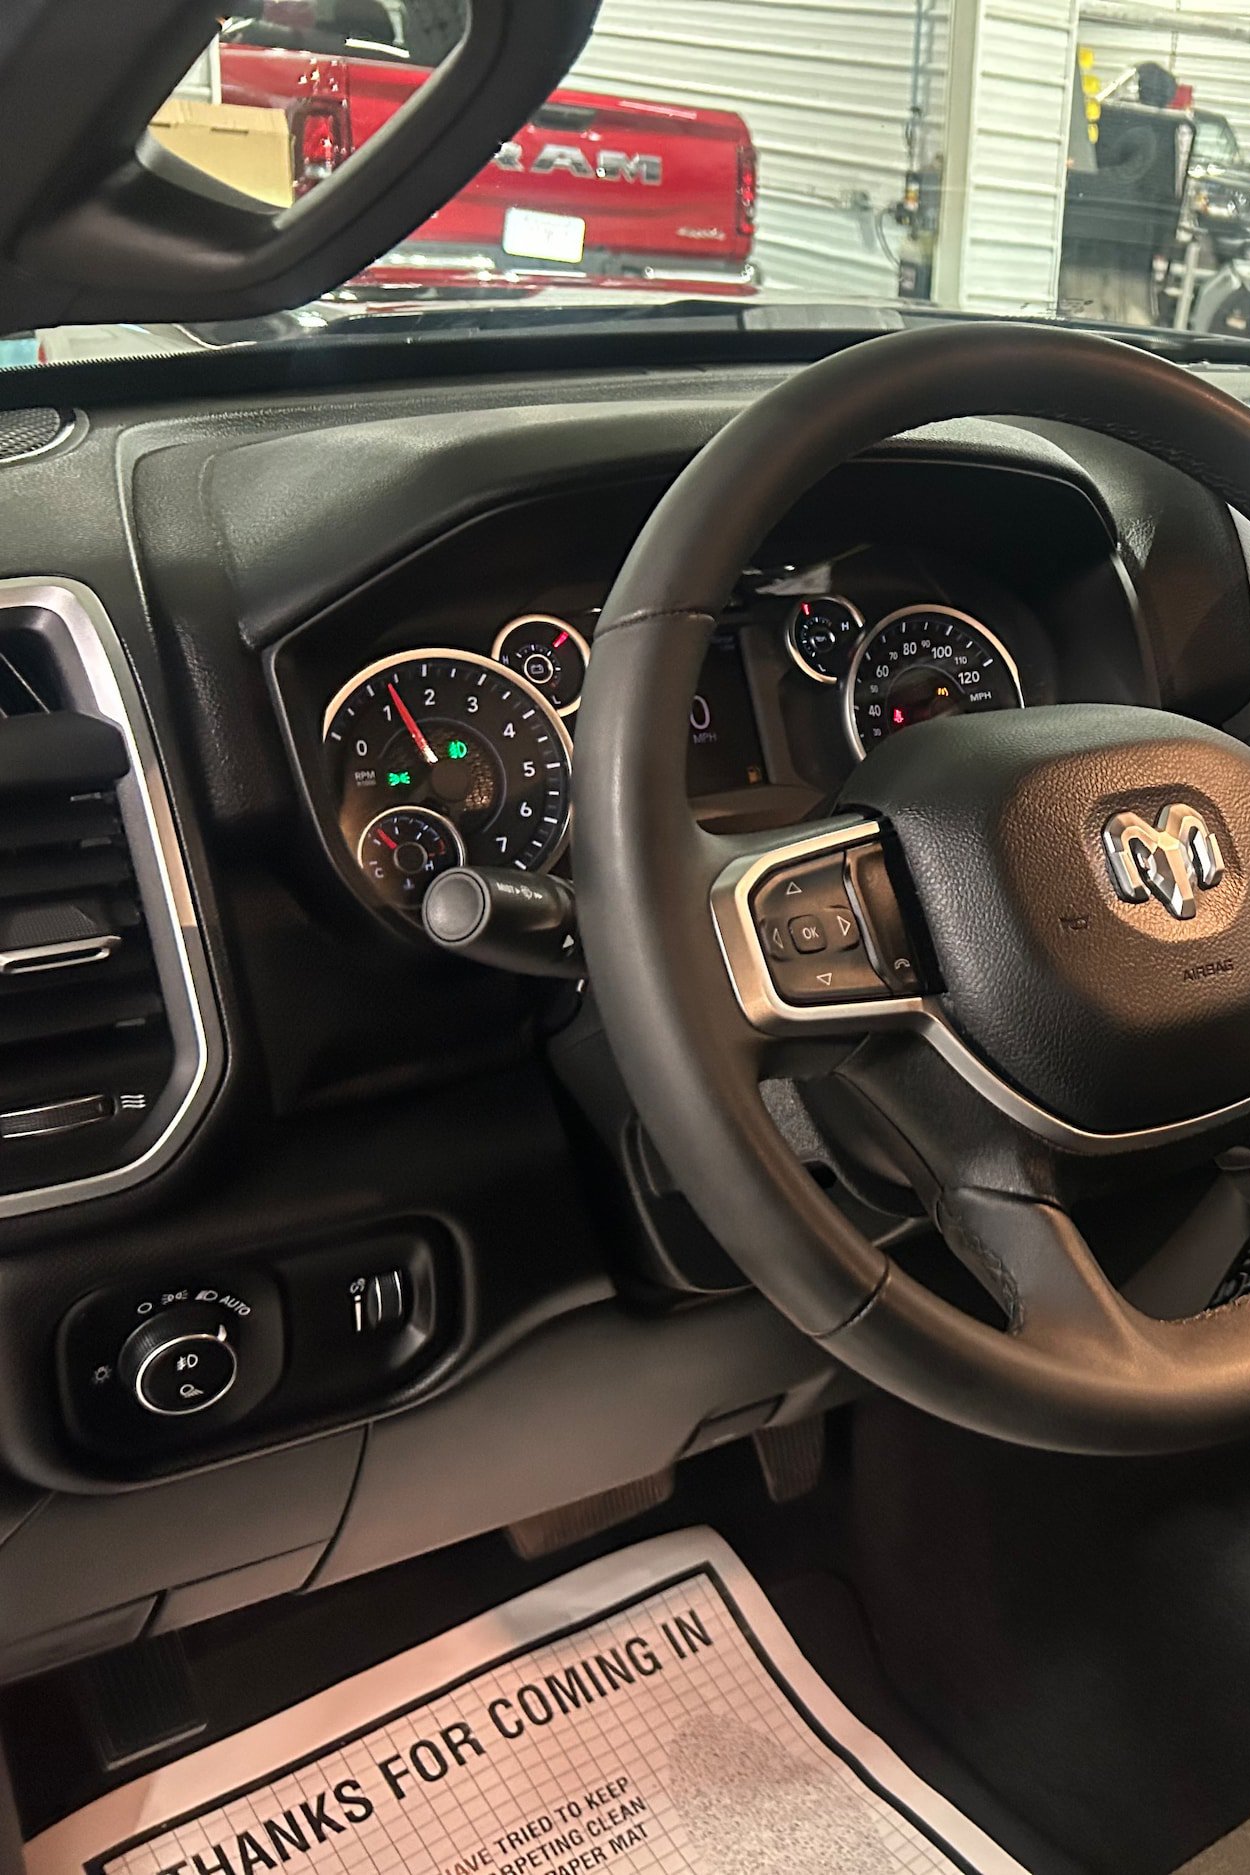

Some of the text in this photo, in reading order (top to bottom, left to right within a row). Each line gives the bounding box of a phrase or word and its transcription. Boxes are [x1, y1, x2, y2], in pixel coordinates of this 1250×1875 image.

[494, 141, 662, 186] RAM
[903, 642, 917, 656] 80
[931, 646, 952, 660] 100
[876, 665, 889, 678] 60
[958, 671, 980, 685] 120
[424, 689, 436, 705] 2
[970, 691, 992, 702] MPH
[383, 705, 392, 721] 1
[467, 697, 479, 713] 3
[868, 704, 881, 717] 40
[503, 723, 515, 738] 4
[356, 740, 368, 756] 0
[355, 770, 376, 781] RPM
[523, 761, 536, 777] 5
[519, 802, 533, 817] 6
[496, 837, 508, 852] 7
[802, 927, 819, 940] OK
[1183, 959, 1234, 982] AIRBAG
[219, 1295, 251, 1316] AUTO
[377, 1721, 487, 1801] FOR
[487, 1636, 663, 1740] COMING
[661, 1609, 715, 1660] IN
[443, 1776, 629, 1875] AVE TRIED TO KEEP
[489, 1796, 647, 1875] RPETING CLEAN
[608, 1821, 649, 1855] MAT
